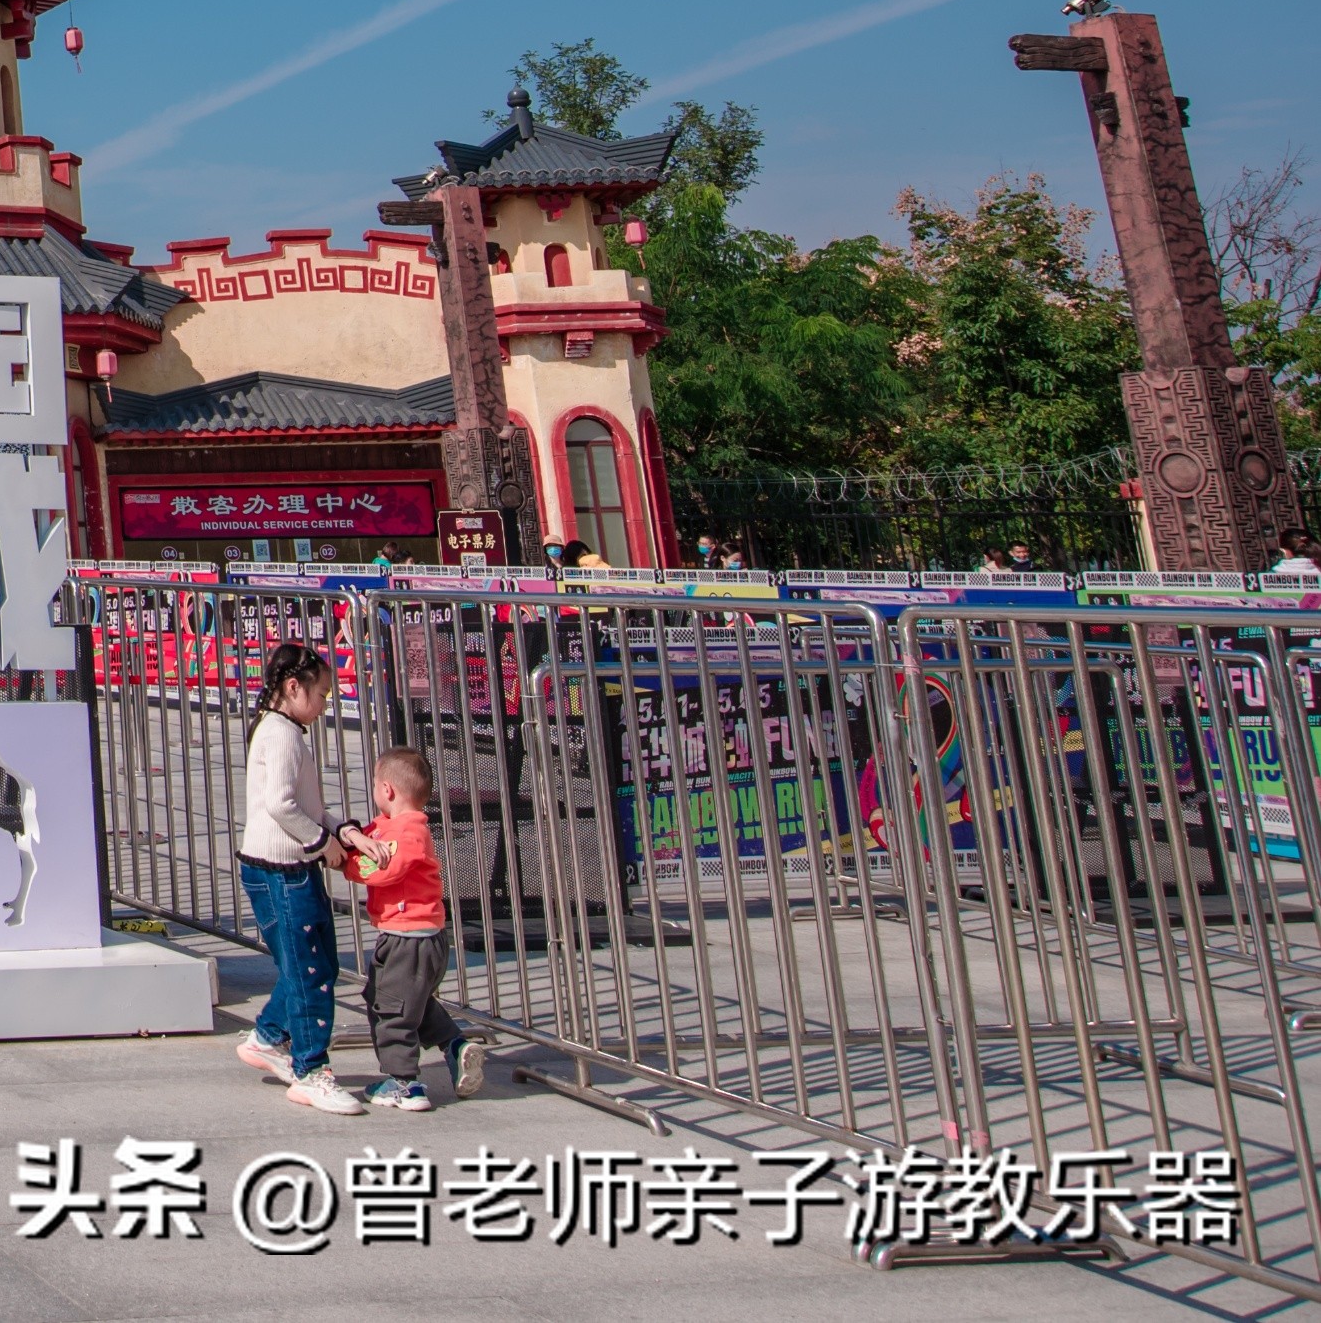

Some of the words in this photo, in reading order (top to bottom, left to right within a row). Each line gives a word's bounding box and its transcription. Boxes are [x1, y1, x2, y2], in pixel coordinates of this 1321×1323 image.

[170, 493, 383, 516] 散客办理中心
[201, 521, 261, 530] INDIVIDUAL
[263, 520, 309, 529] SERVICE
[310, 519, 355, 529] CENTER
[447, 532, 496, 549] 电子票房
[164, 550, 176, 558] 04
[227, 549, 239, 558] 03
[321, 547, 334, 557] 02
[1086, 572, 1117, 582] RAINBOW
[1161, 573, 1195, 583] RAINBOW
[1263, 574, 1300, 585] RAINBOW
